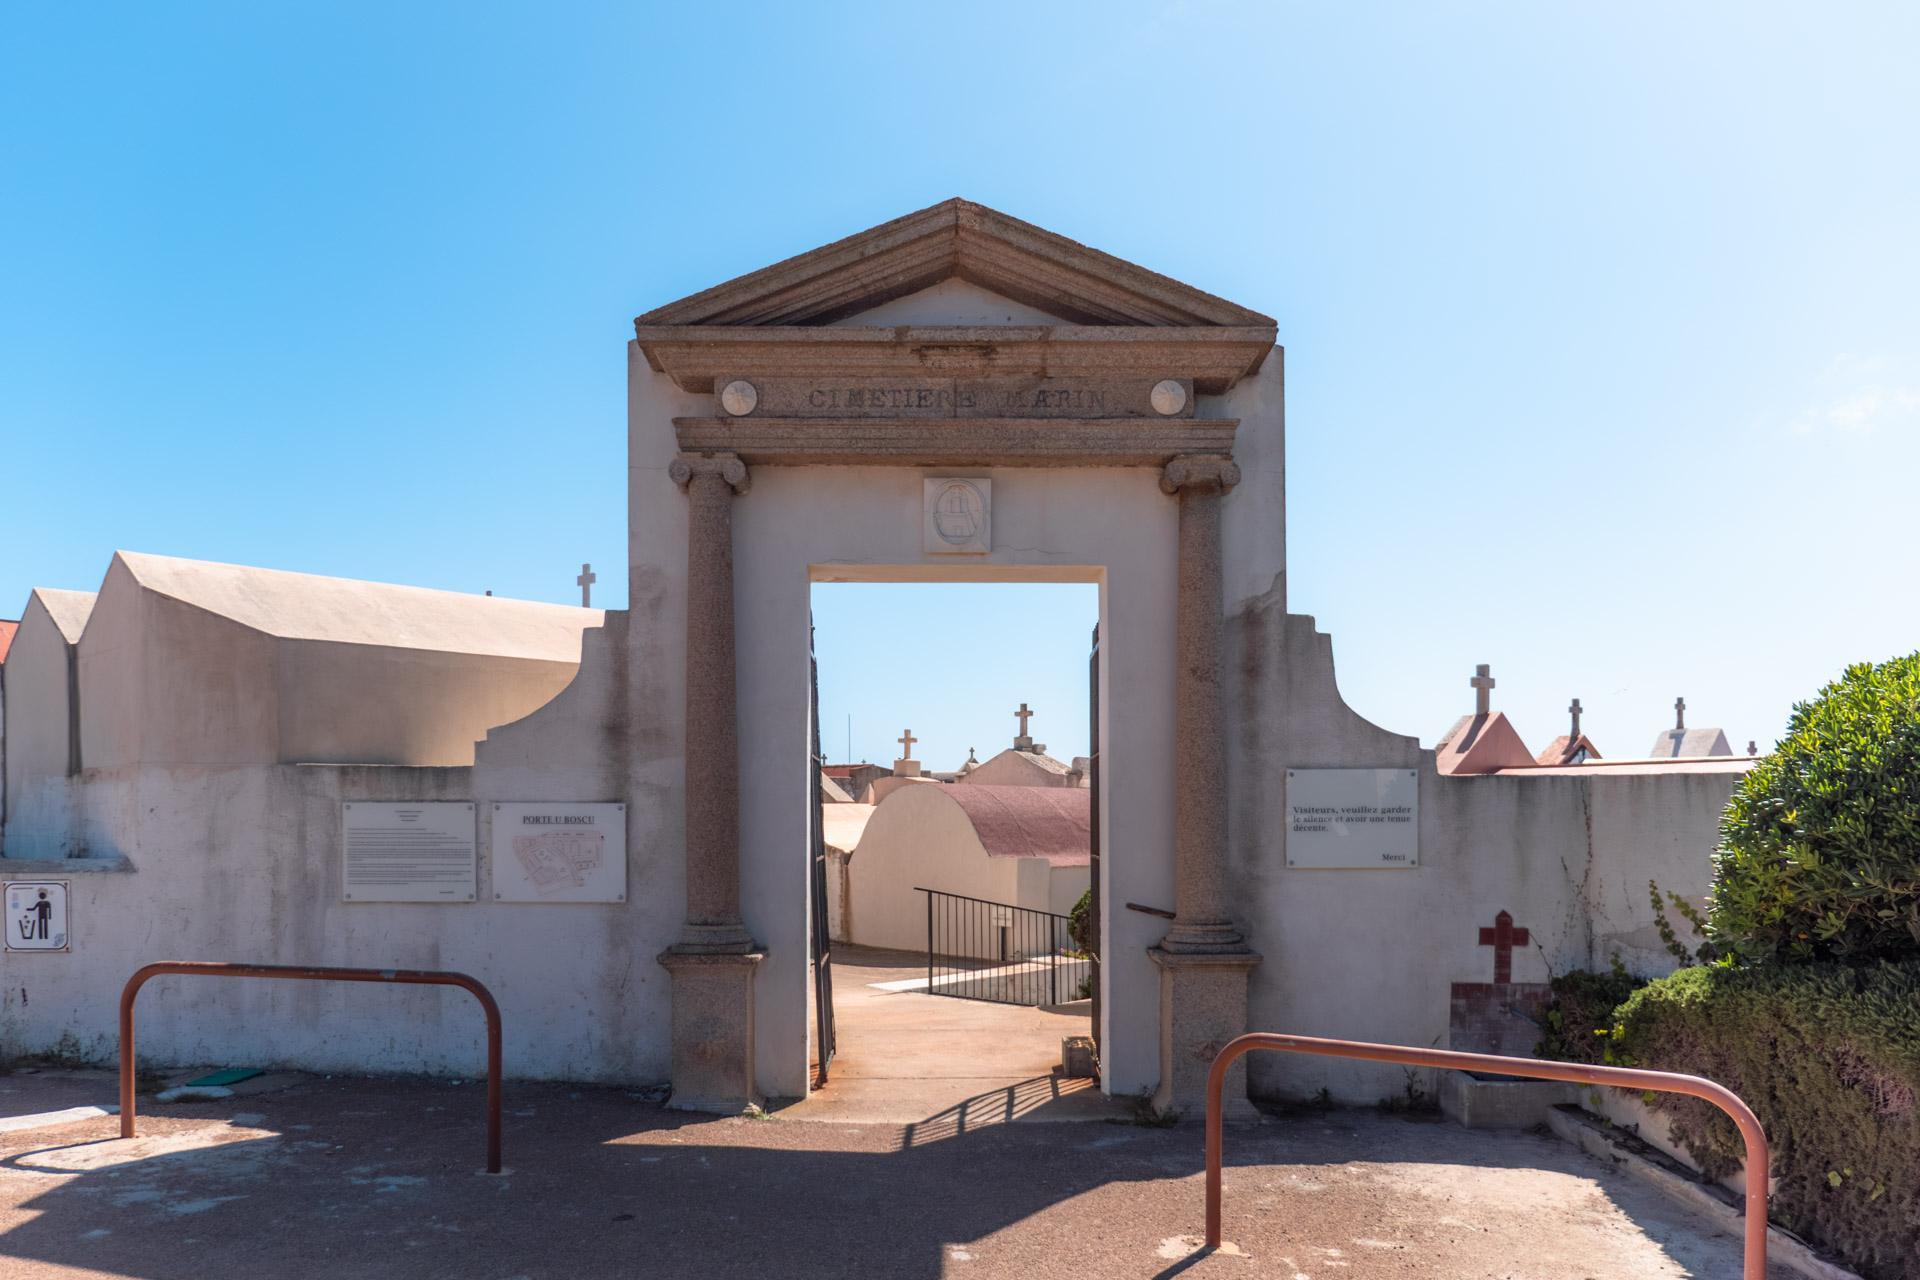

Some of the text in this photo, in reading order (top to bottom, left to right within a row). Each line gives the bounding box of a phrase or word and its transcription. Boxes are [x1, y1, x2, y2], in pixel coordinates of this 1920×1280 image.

[1293, 806, 1412, 815] Visiteurs, veuillez garder
[522, 815, 595, 825] PORTE U BOSCU
[1293, 815, 1302, 823] le
[1303, 815, 1333, 823] silence
[1335, 815, 1343, 823] et
[1345, 815, 1367, 823] avoir
[1387, 815, 1411, 823] tenue
